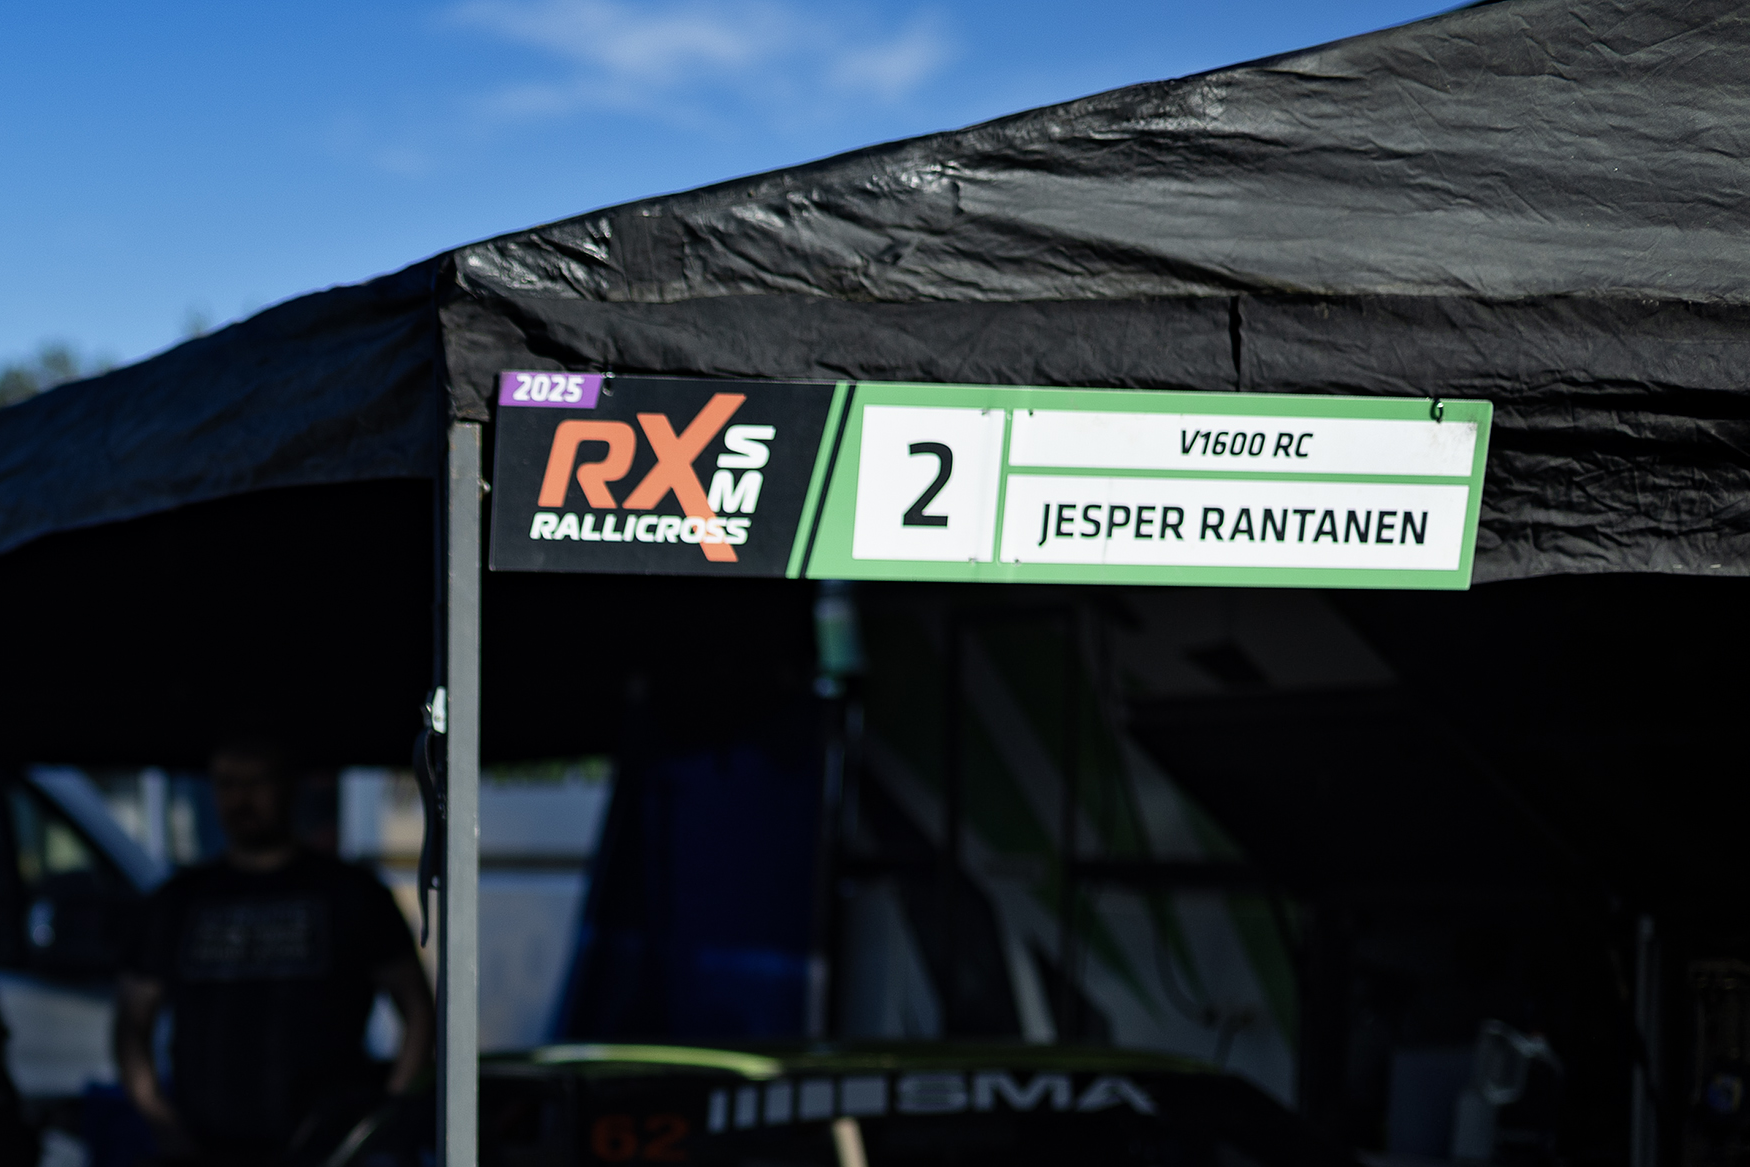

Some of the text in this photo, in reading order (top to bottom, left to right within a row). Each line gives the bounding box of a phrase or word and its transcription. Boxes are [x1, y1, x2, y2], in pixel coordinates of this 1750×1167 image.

[512, 374, 585, 403] 2025
[1180, 429, 1314, 459] V1600 RC
[537, 392, 747, 562] RX
[902, 441, 954, 528] 2
[529, 511, 752, 546] RALLICROSS
[1038, 503, 1429, 547] JESPER RANTANEN
[894, 1069, 1157, 1117] SMA
[590, 1112, 692, 1163] 62
